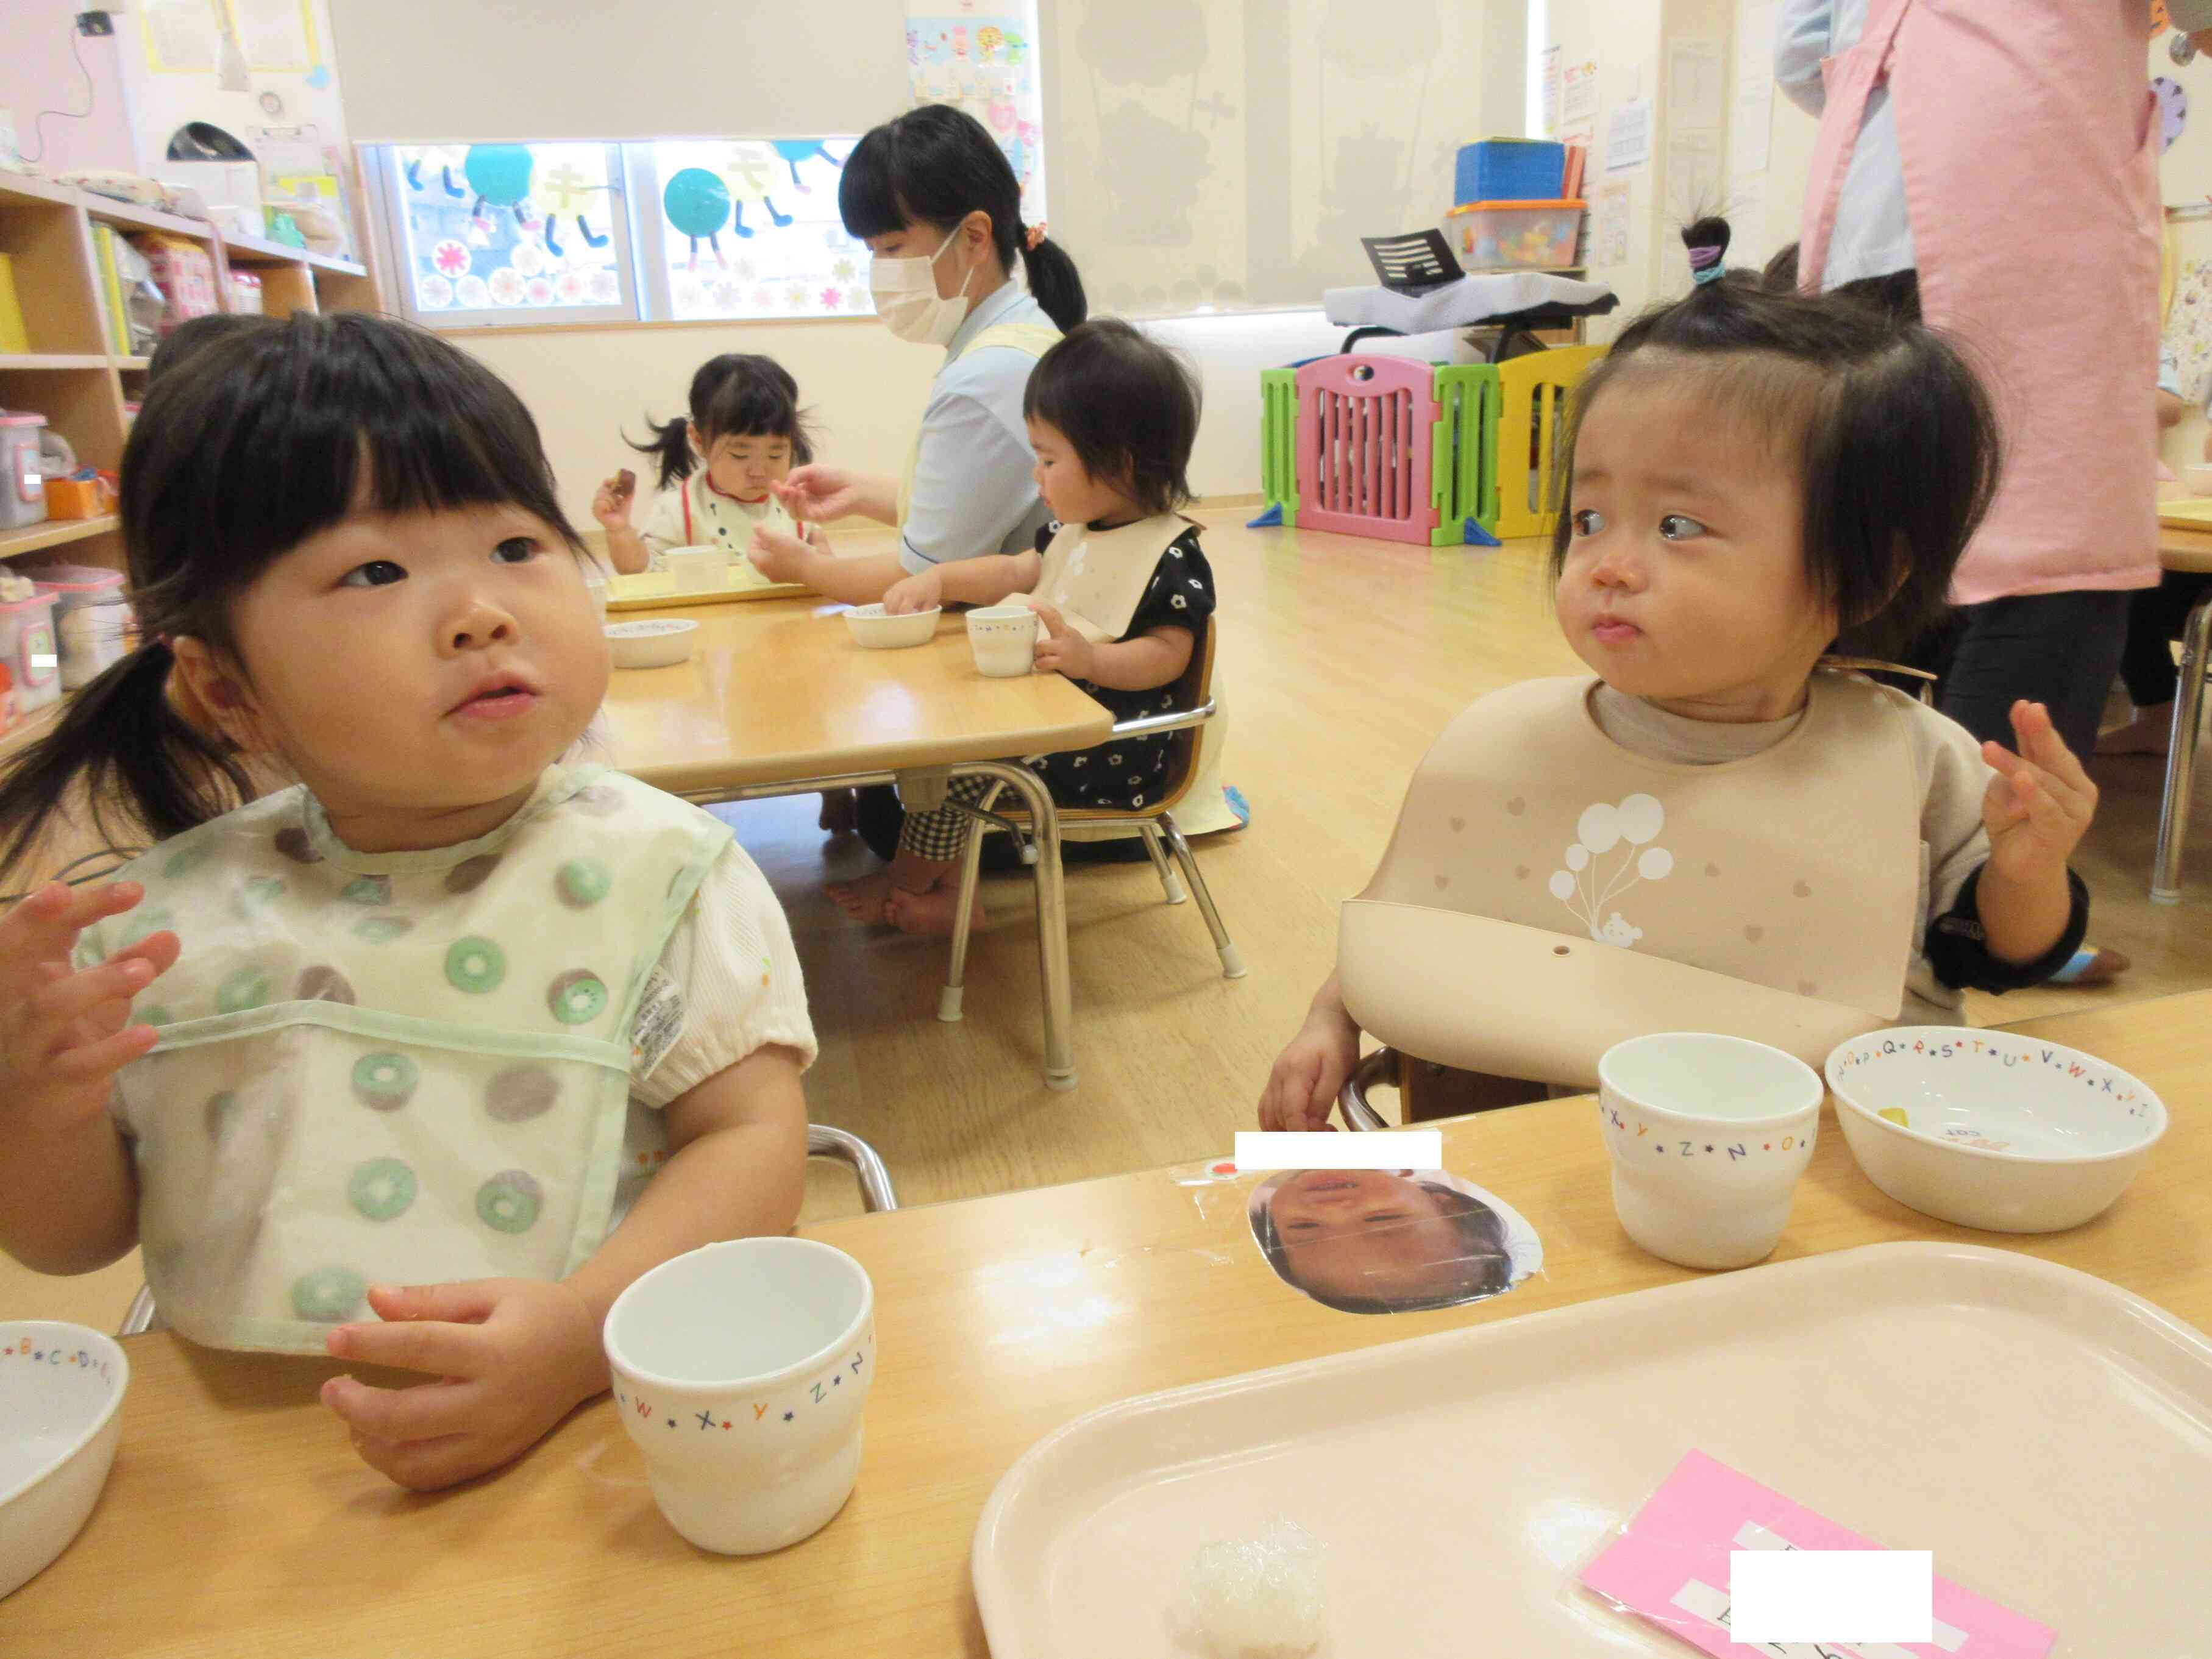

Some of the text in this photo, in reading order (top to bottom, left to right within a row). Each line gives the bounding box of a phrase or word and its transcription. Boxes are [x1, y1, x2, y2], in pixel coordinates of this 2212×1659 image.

[1883, 1040, 1897, 1054] Q
[1913, 1040, 1924, 1054] R
[1941, 1044, 1953, 1057] S
[1972, 1039, 1985, 1053] T
[2004, 1053, 2016, 1067] U
[2042, 1050, 2054, 1064] V
[2068, 1062, 2086, 1078] W
[2102, 1078, 2113, 1093] X
[1611, 1110, 1794, 1160] X Y Z N O
[49, 1350, 61, 1365] C
[635, 1396, 652, 1419] W
[695, 1410, 716, 1431] X
[753, 1403, 769, 1421] Y
[809, 1382, 827, 1404] Z
